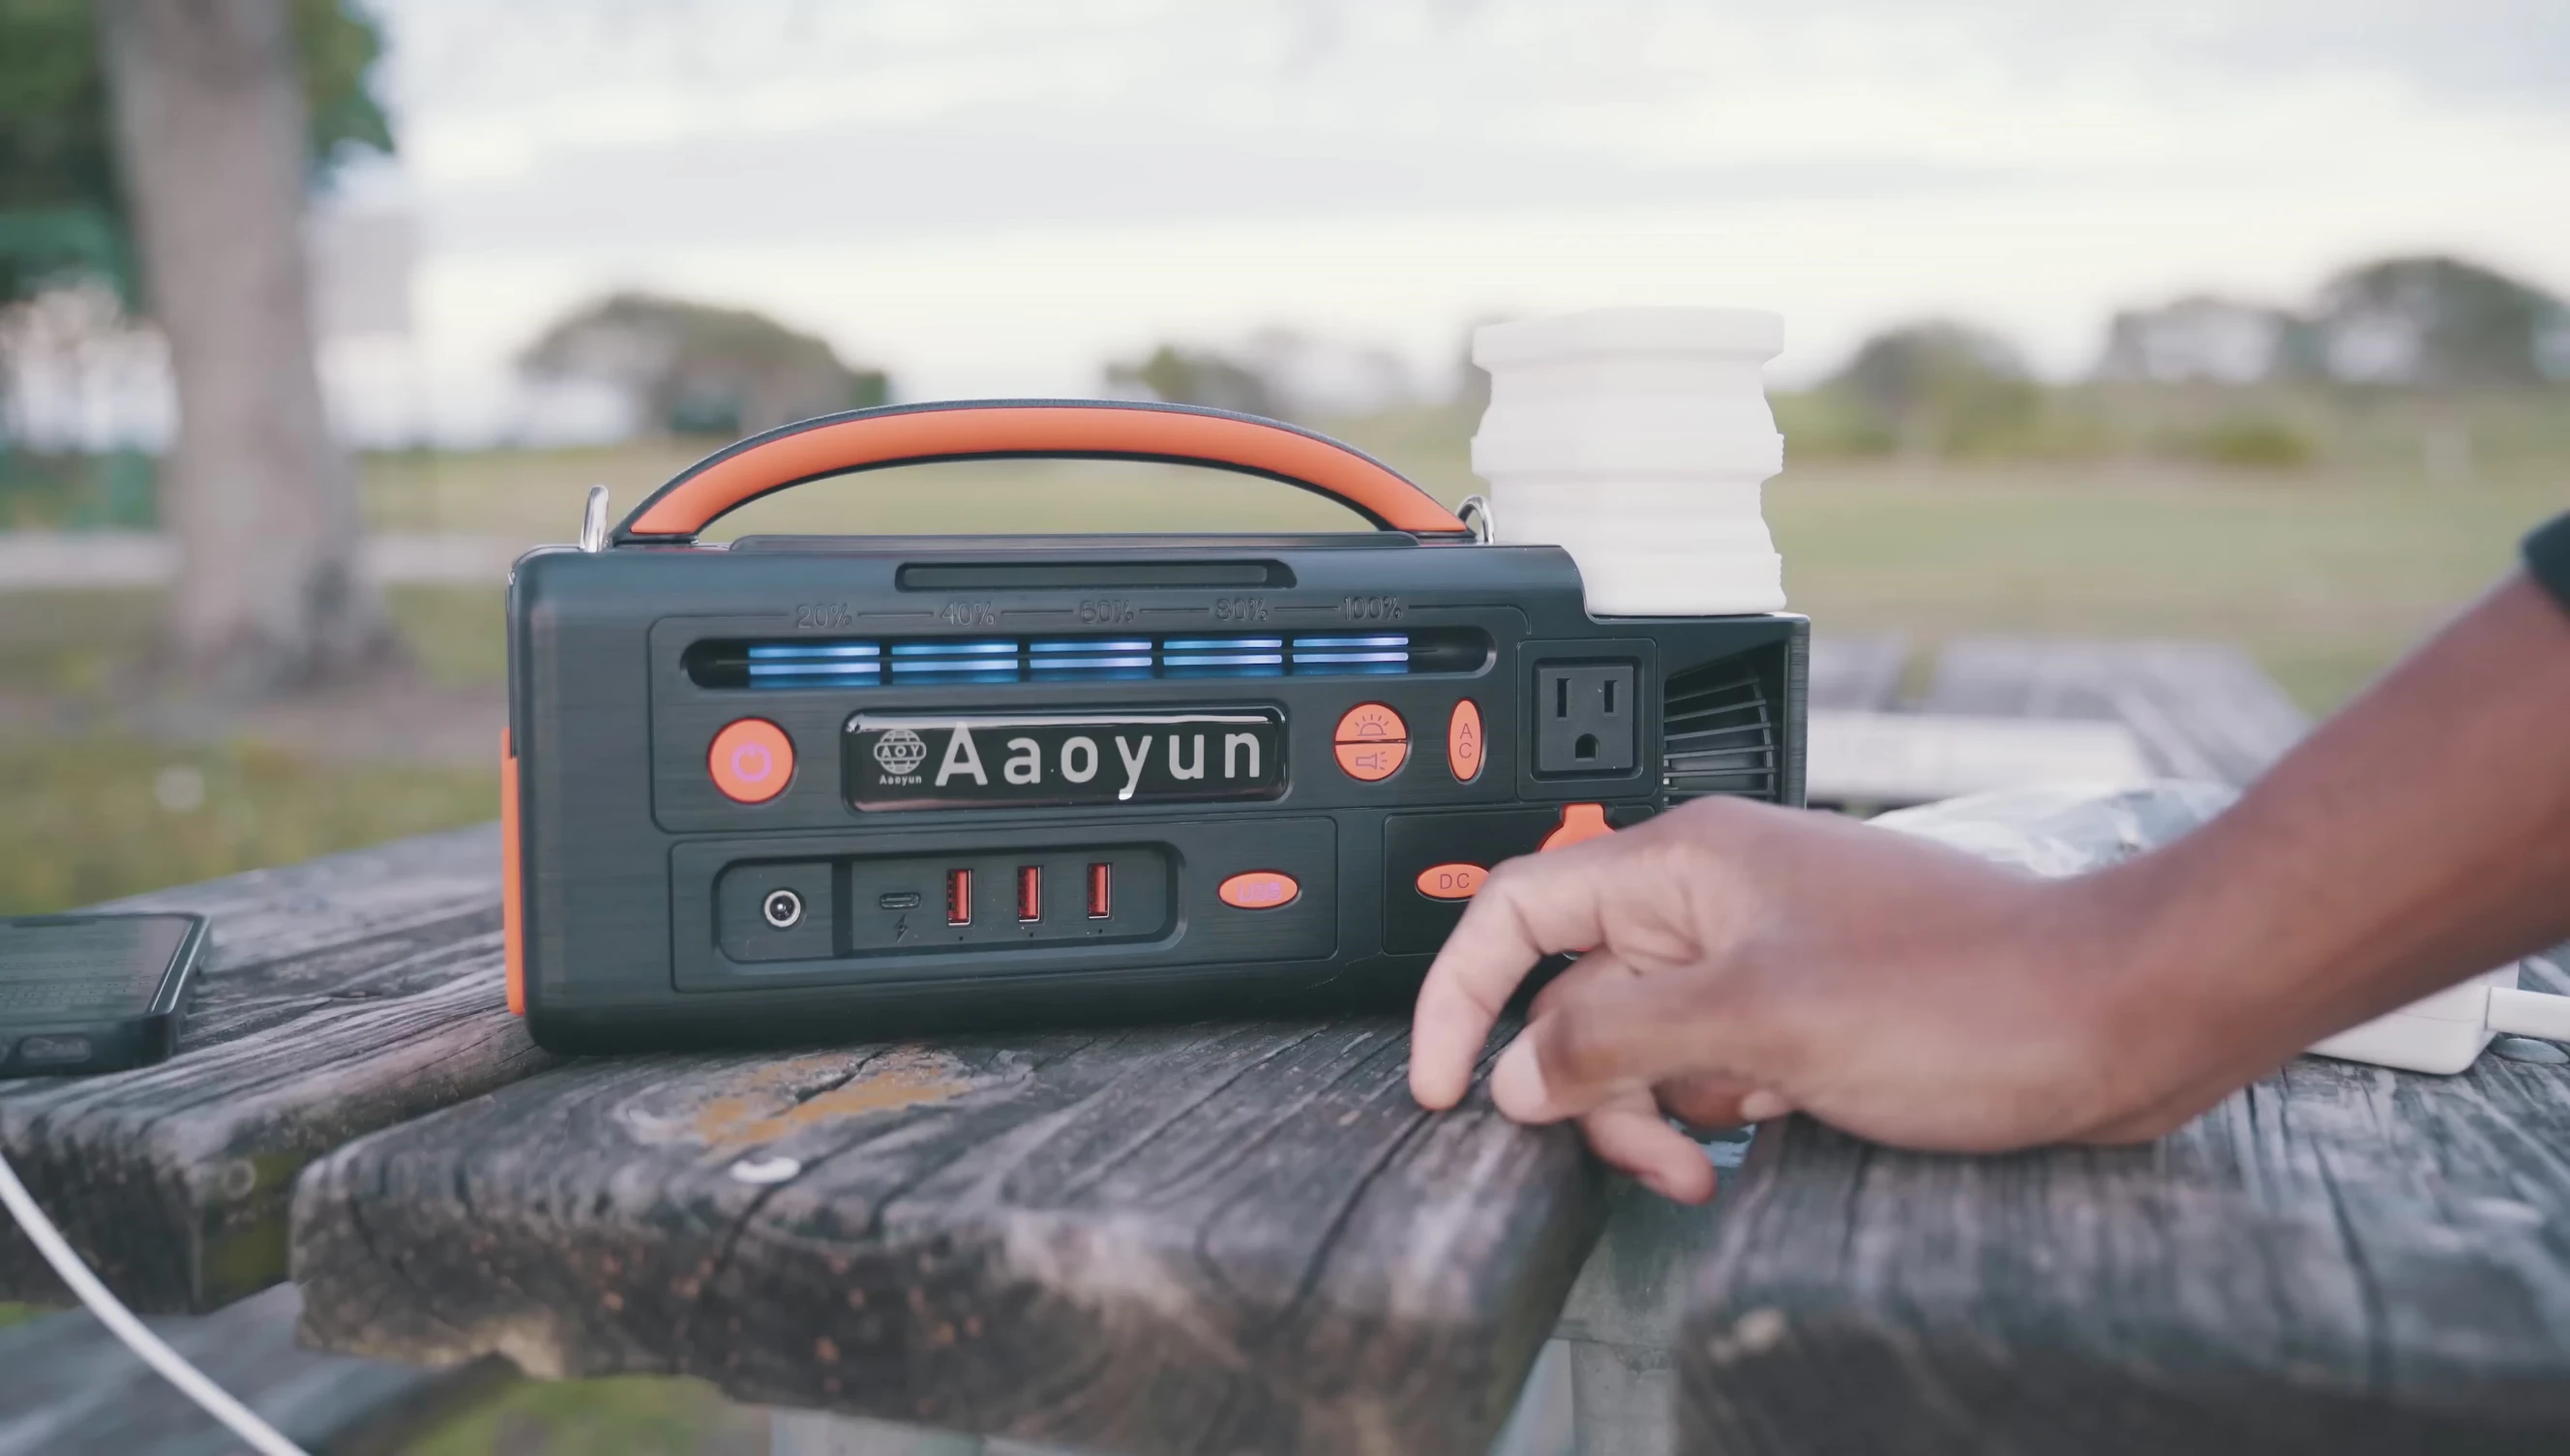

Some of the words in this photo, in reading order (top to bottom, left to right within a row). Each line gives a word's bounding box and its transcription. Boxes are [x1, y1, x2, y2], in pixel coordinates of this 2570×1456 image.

[796, 604, 852, 628] 20%
[941, 602, 996, 626] 40%
[1081, 600, 1134, 625] 60%
[1215, 597, 1269, 622] 80%
[1343, 596, 1402, 620] 100%
[882, 744, 920, 759] AOY
[1458, 723, 1474, 759] AC
[935, 721, 1260, 800] Aaoyun
[879, 774, 922, 787] Aaoyun
[1439, 872, 1471, 890] DC
